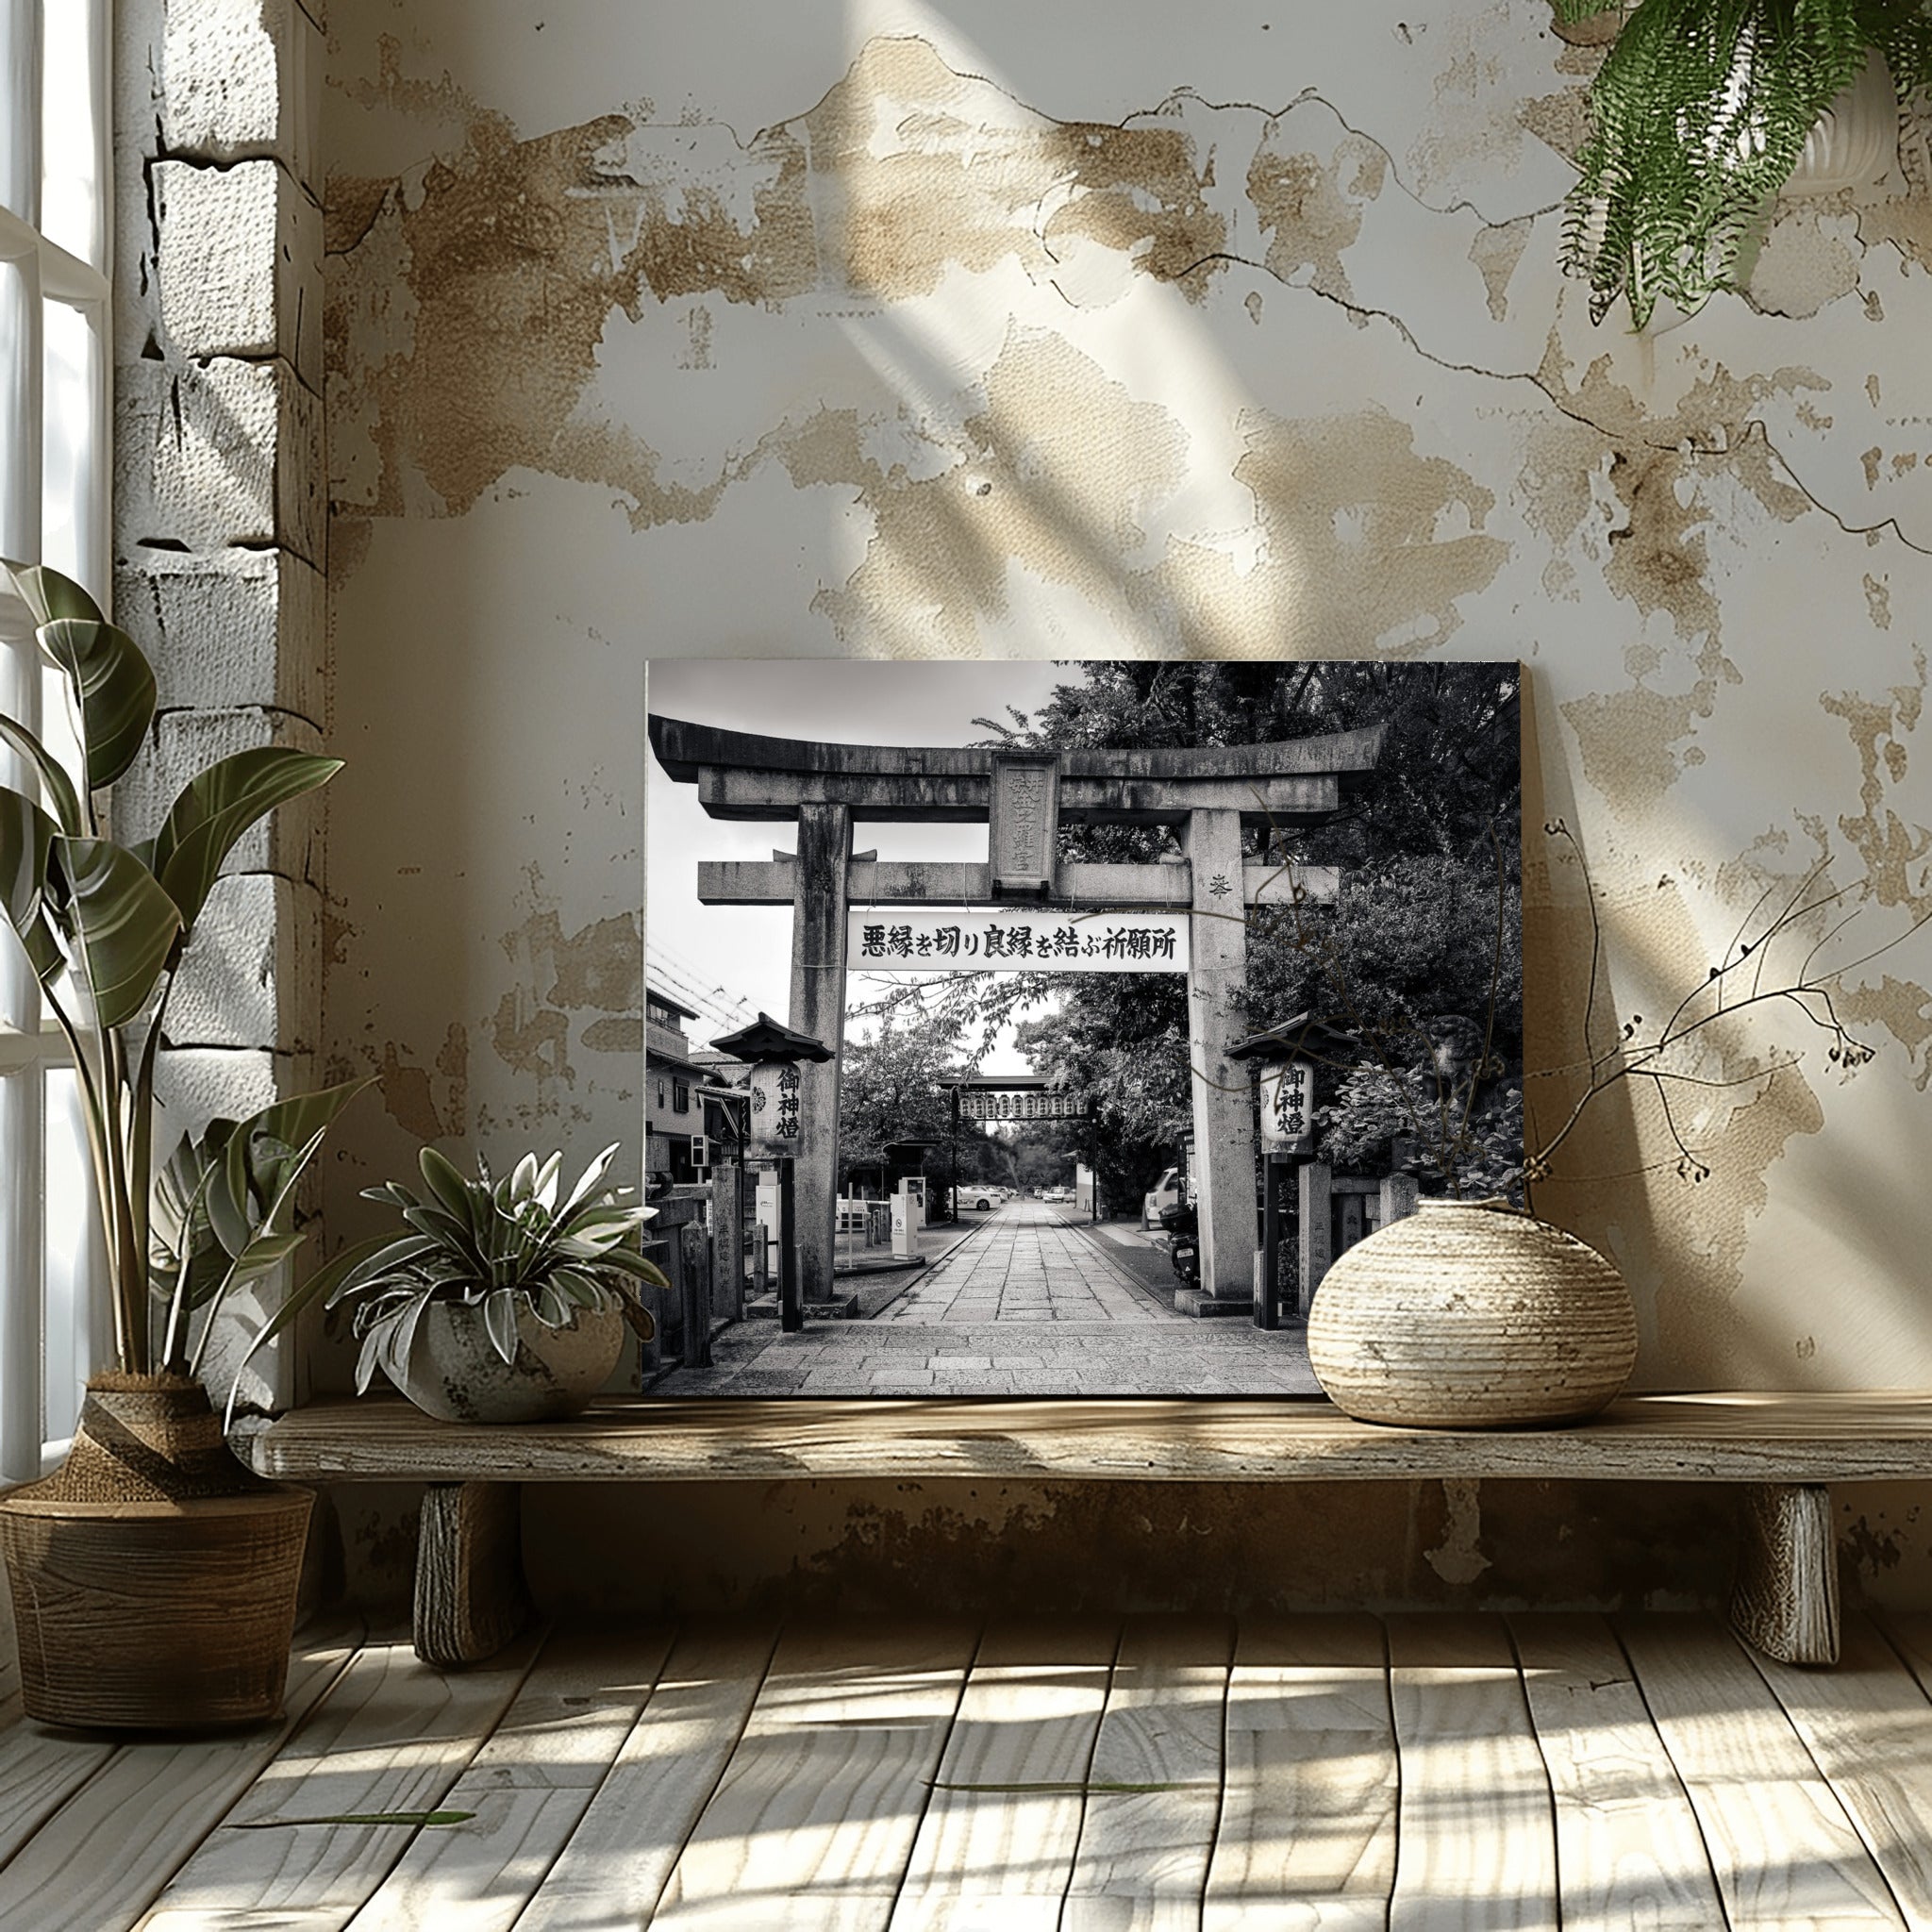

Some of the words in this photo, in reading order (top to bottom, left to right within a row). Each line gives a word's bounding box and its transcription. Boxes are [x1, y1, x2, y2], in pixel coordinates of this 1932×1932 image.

[1209, 874, 1233, 900] 奉
[861, 924, 1176, 960] 悪縁を切り良縁を結ぶ祈願所
